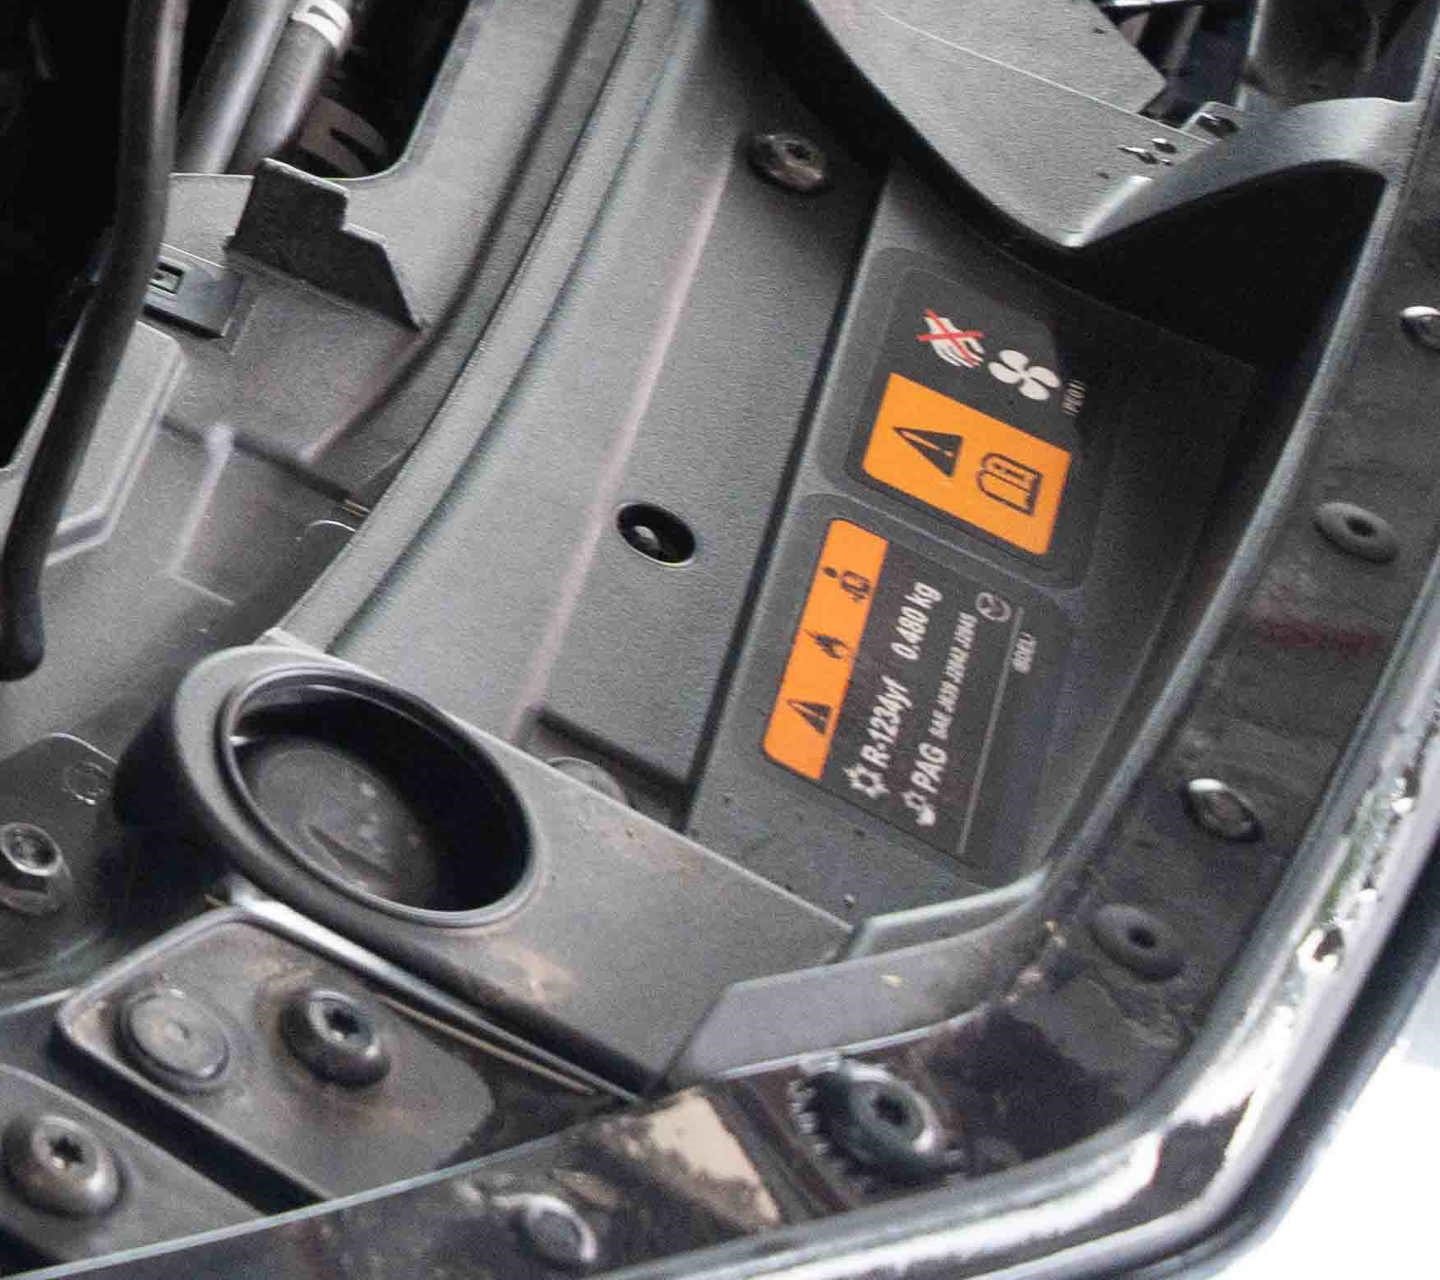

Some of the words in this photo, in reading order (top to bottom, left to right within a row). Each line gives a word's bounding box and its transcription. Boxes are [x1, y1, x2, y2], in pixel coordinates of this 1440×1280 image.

[904, 581, 943, 611] kg
[891, 606, 930, 661] 0.480
[861, 675, 913, 769] R-1234yf
[911, 742, 947, 795] PAG
